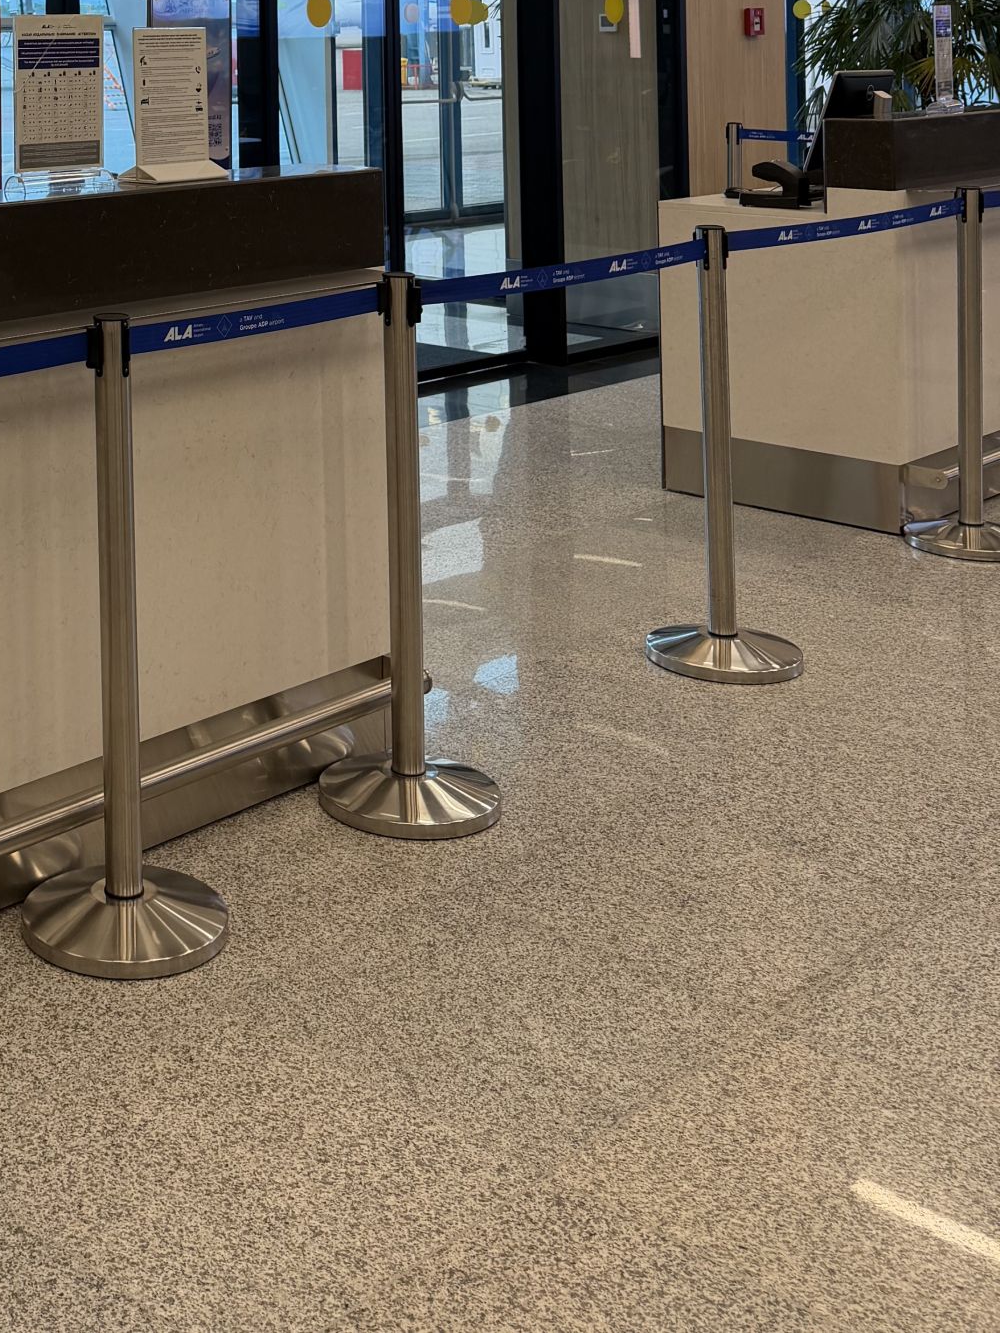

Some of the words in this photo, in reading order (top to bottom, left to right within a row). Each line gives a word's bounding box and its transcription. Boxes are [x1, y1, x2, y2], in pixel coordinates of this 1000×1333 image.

[858, 219, 872, 231] ALA
[777, 229, 793, 241] ALA
[609, 259, 627, 273] ALA
[500, 275, 520, 290] ALA
[163, 324, 193, 342] ALA
